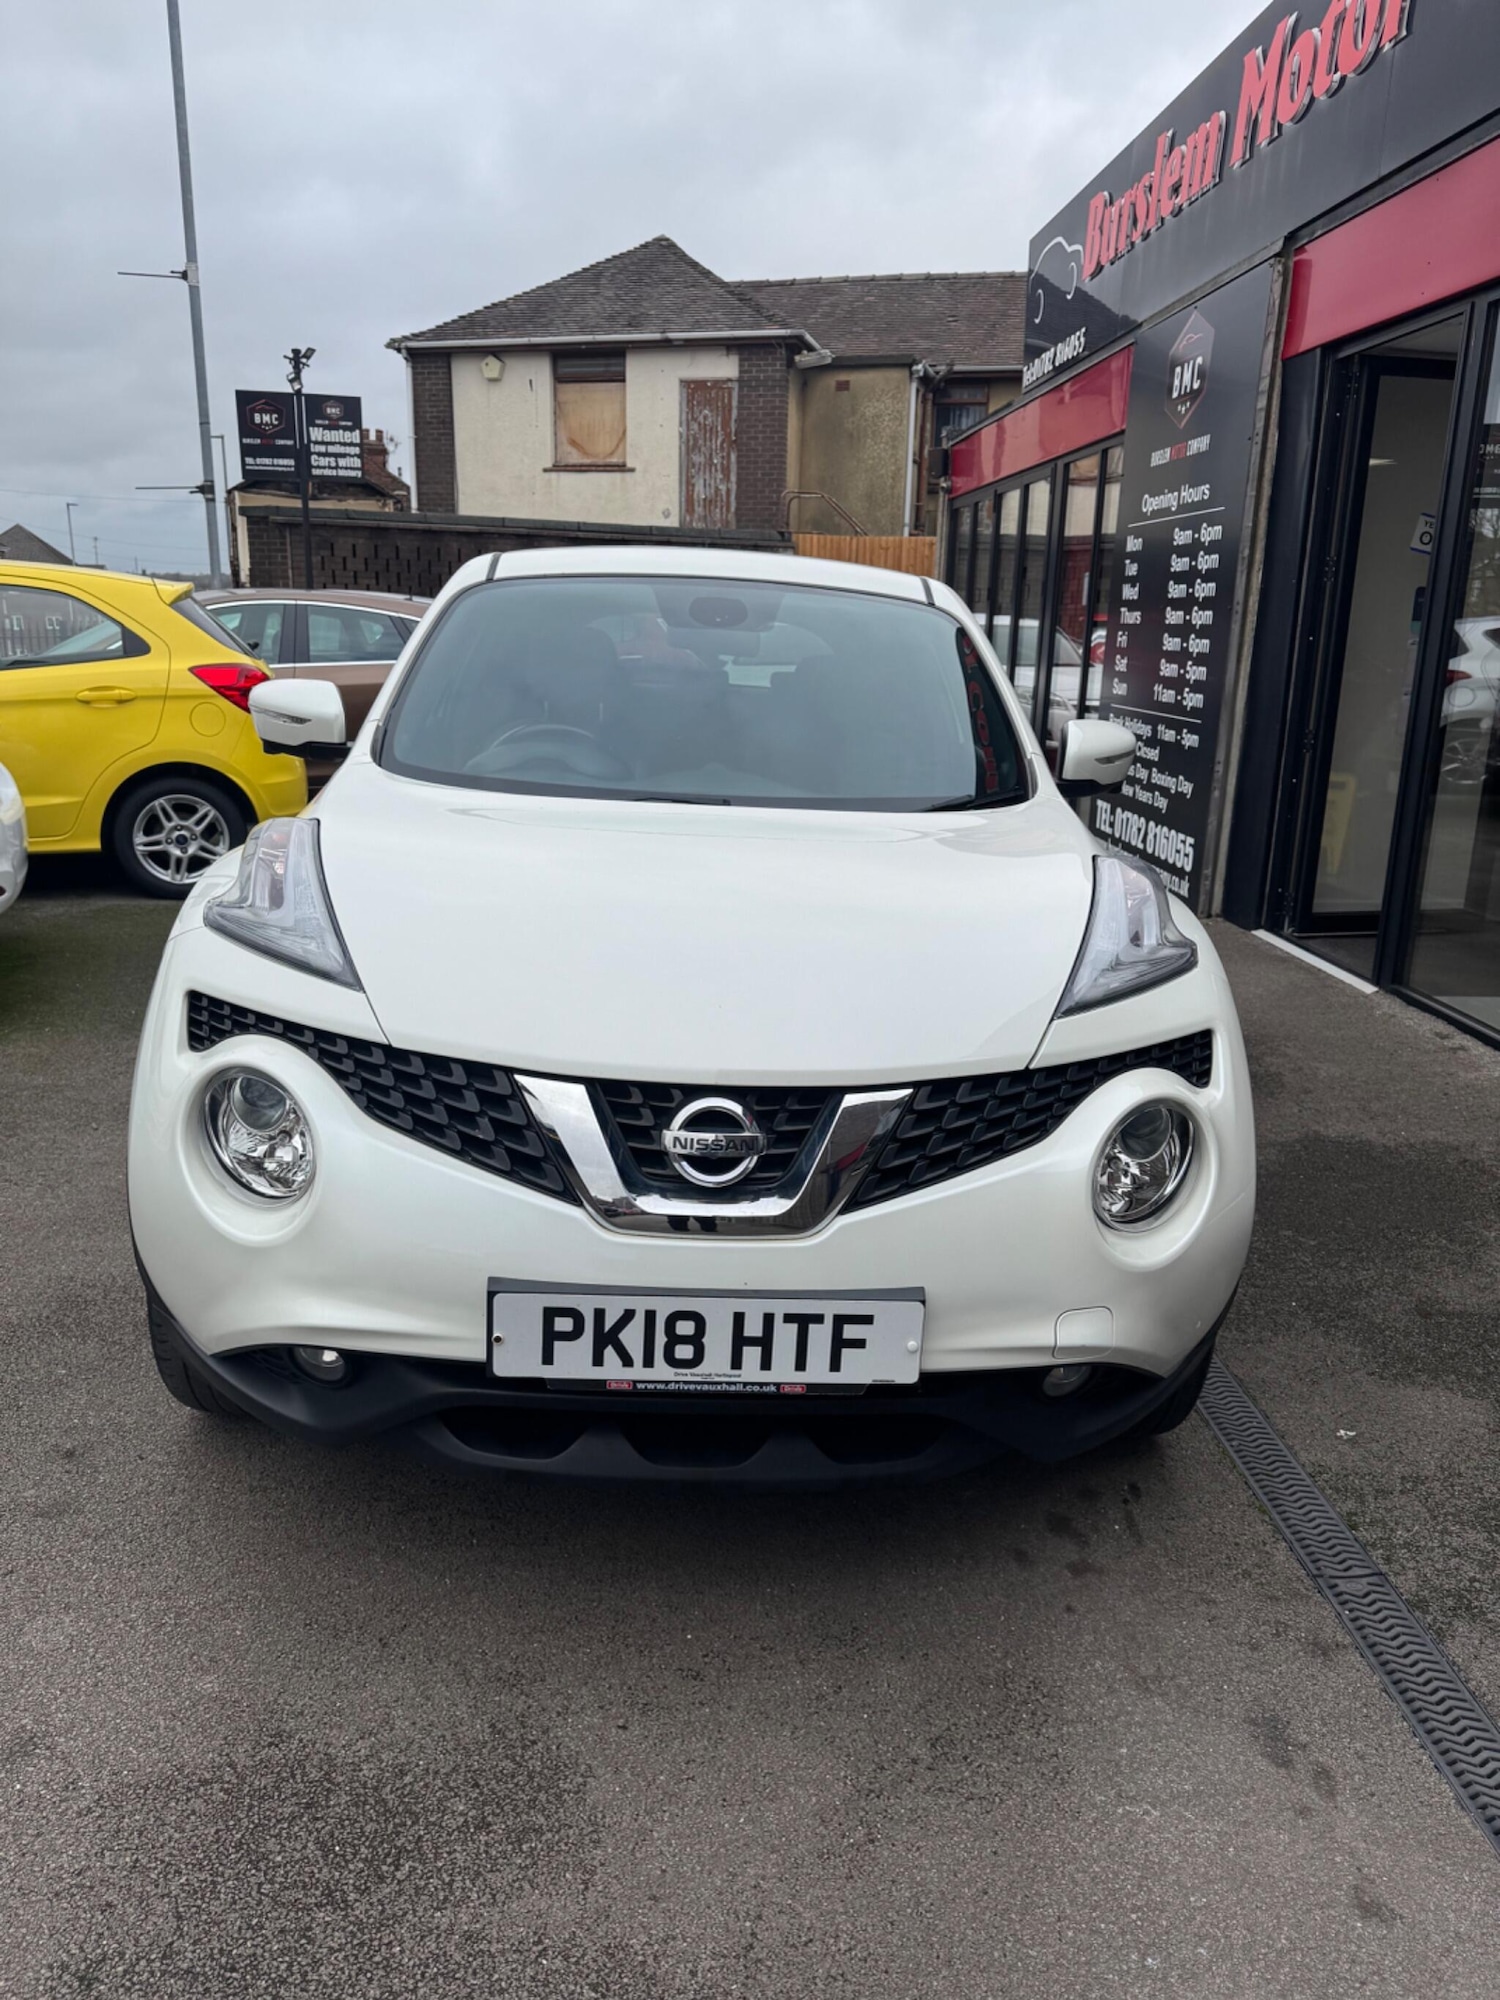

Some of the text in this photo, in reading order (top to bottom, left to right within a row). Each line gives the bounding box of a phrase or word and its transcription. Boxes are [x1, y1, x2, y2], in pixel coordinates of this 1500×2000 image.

[1082, 110, 1226, 282] Burslem
[1055, 326, 1086, 367] 816055
[1172, 356, 1203, 399] BMC
[253, 413, 279, 425] BMC
[309, 427, 361, 444] Wanted
[310, 443, 360, 456] Low mileage
[310, 454, 362, 468] Cars with
[1142, 484, 1210, 516] Opening Hours
[1126, 535, 1143, 552] Mon
[1173, 527, 1192, 546] 9am
[1200, 522, 1222, 546] 6pm
[1124, 559, 1138, 576] Tue
[1170, 553, 1190, 572] 9am
[1197, 550, 1220, 574] 6pm
[1122, 583, 1139, 600] Wed
[1167, 580, 1187, 599] 9am
[1194, 578, 1216, 602] 6pm
[1120, 607, 1141, 624] Thurs
[1165, 606, 1184, 624] 9am
[1191, 606, 1213, 630] 6pm
[1116, 631, 1128, 648] Fri
[1162, 633, 1181, 651] 9am
[1188, 633, 1210, 658] 6pm
[1114, 654, 1128, 672] Sat
[1159, 658, 1178, 677] 9am
[1185, 660, 1207, 684] 5pm
[1112, 678, 1127, 695] Sun
[1153, 683, 1175, 704] 11am
[1182, 687, 1204, 711] 5pm
[1157, 724, 1176, 742] 11am
[1181, 728, 1200, 750] 5pm
[1136, 741, 1160, 761] Closed
[1135, 763, 1150, 784] Day
[1151, 767, 1177, 794] Boxing
[1177, 775, 1194, 799] Day
[1135, 784, 1153, 805] Years
[1153, 791, 1168, 814] Day
[1096, 799, 1113, 835] TEL:
[1114, 807, 1146, 850] 01782
[1146, 820, 1195, 873] 816055
[673, 1136, 754, 1151] NISSAN
[541, 1306, 875, 1374] PK18 HTF
[636, 1382, 777, 1393] www.drivevauxhall.co.uk
